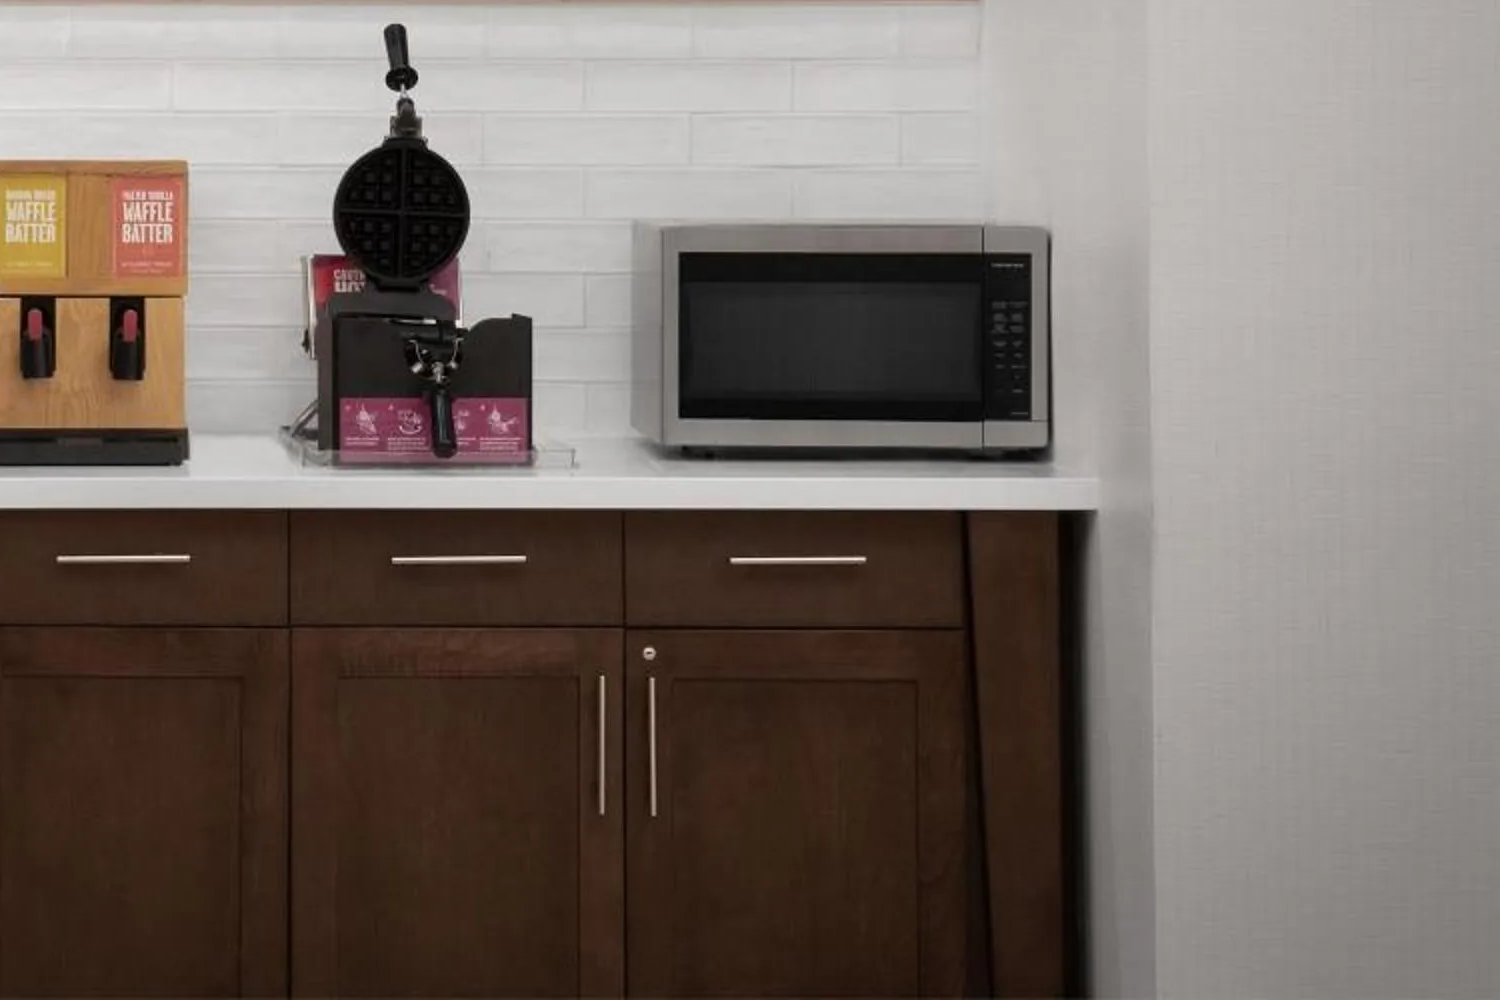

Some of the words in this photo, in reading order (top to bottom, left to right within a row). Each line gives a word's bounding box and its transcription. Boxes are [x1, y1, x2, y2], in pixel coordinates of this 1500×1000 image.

[6, 202, 56, 221] WAFFLE
[122, 202, 173, 222] WAFFLE
[5, 223, 56, 243] BATTER
[121, 223, 173, 243] BATTER
